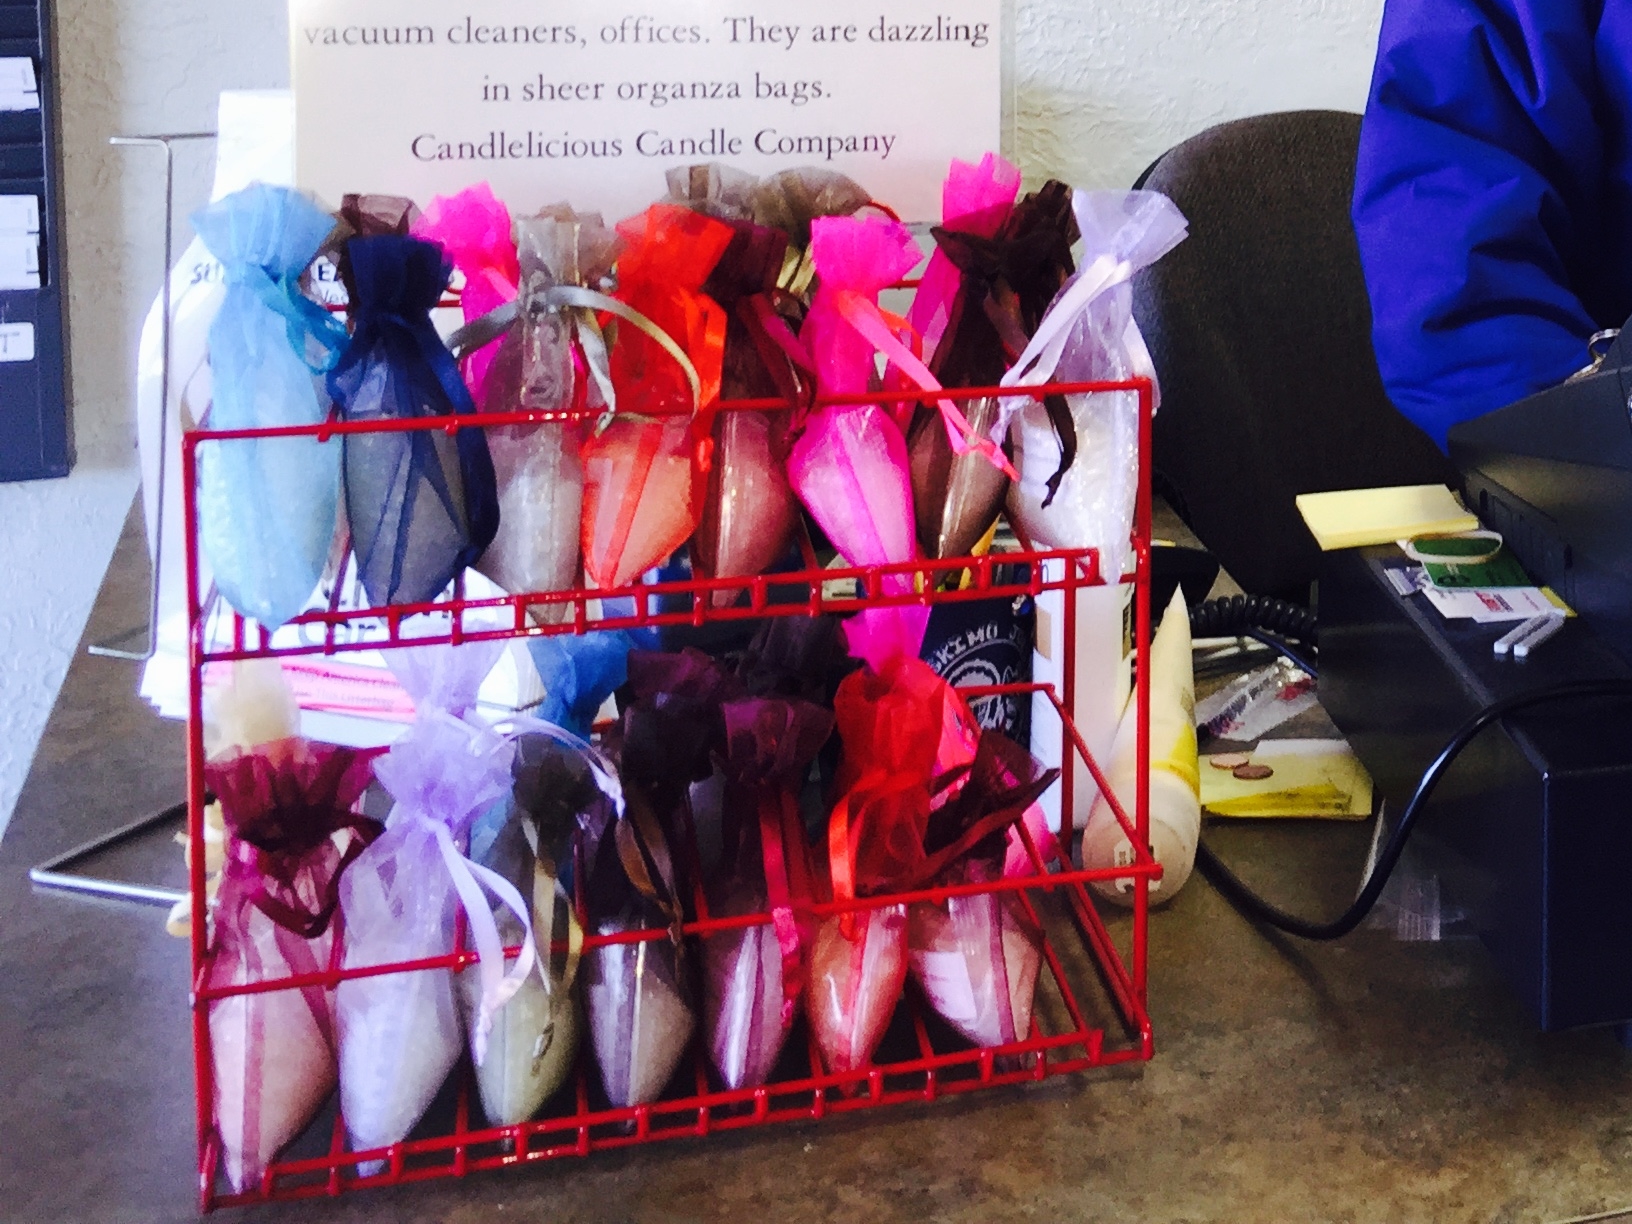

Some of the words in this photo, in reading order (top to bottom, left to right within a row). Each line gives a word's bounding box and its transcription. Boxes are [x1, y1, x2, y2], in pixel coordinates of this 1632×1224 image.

[303, 24, 435, 47] vacuum
[447, 15, 587, 50] cleaners,
[599, 15, 711, 45] offices.
[723, 15, 800, 51] They
[811, 22, 858, 44] are
[867, 14, 990, 49] dazzling
[481, 74, 511, 103] in
[521, 72, 605, 103] sheer
[616, 79, 742, 109] organza
[754, 71, 832, 107] bags.
[410, 129, 623, 163] Candlelicious
[635, 127, 743, 158] Candle
[753, 127, 897, 162] Company
